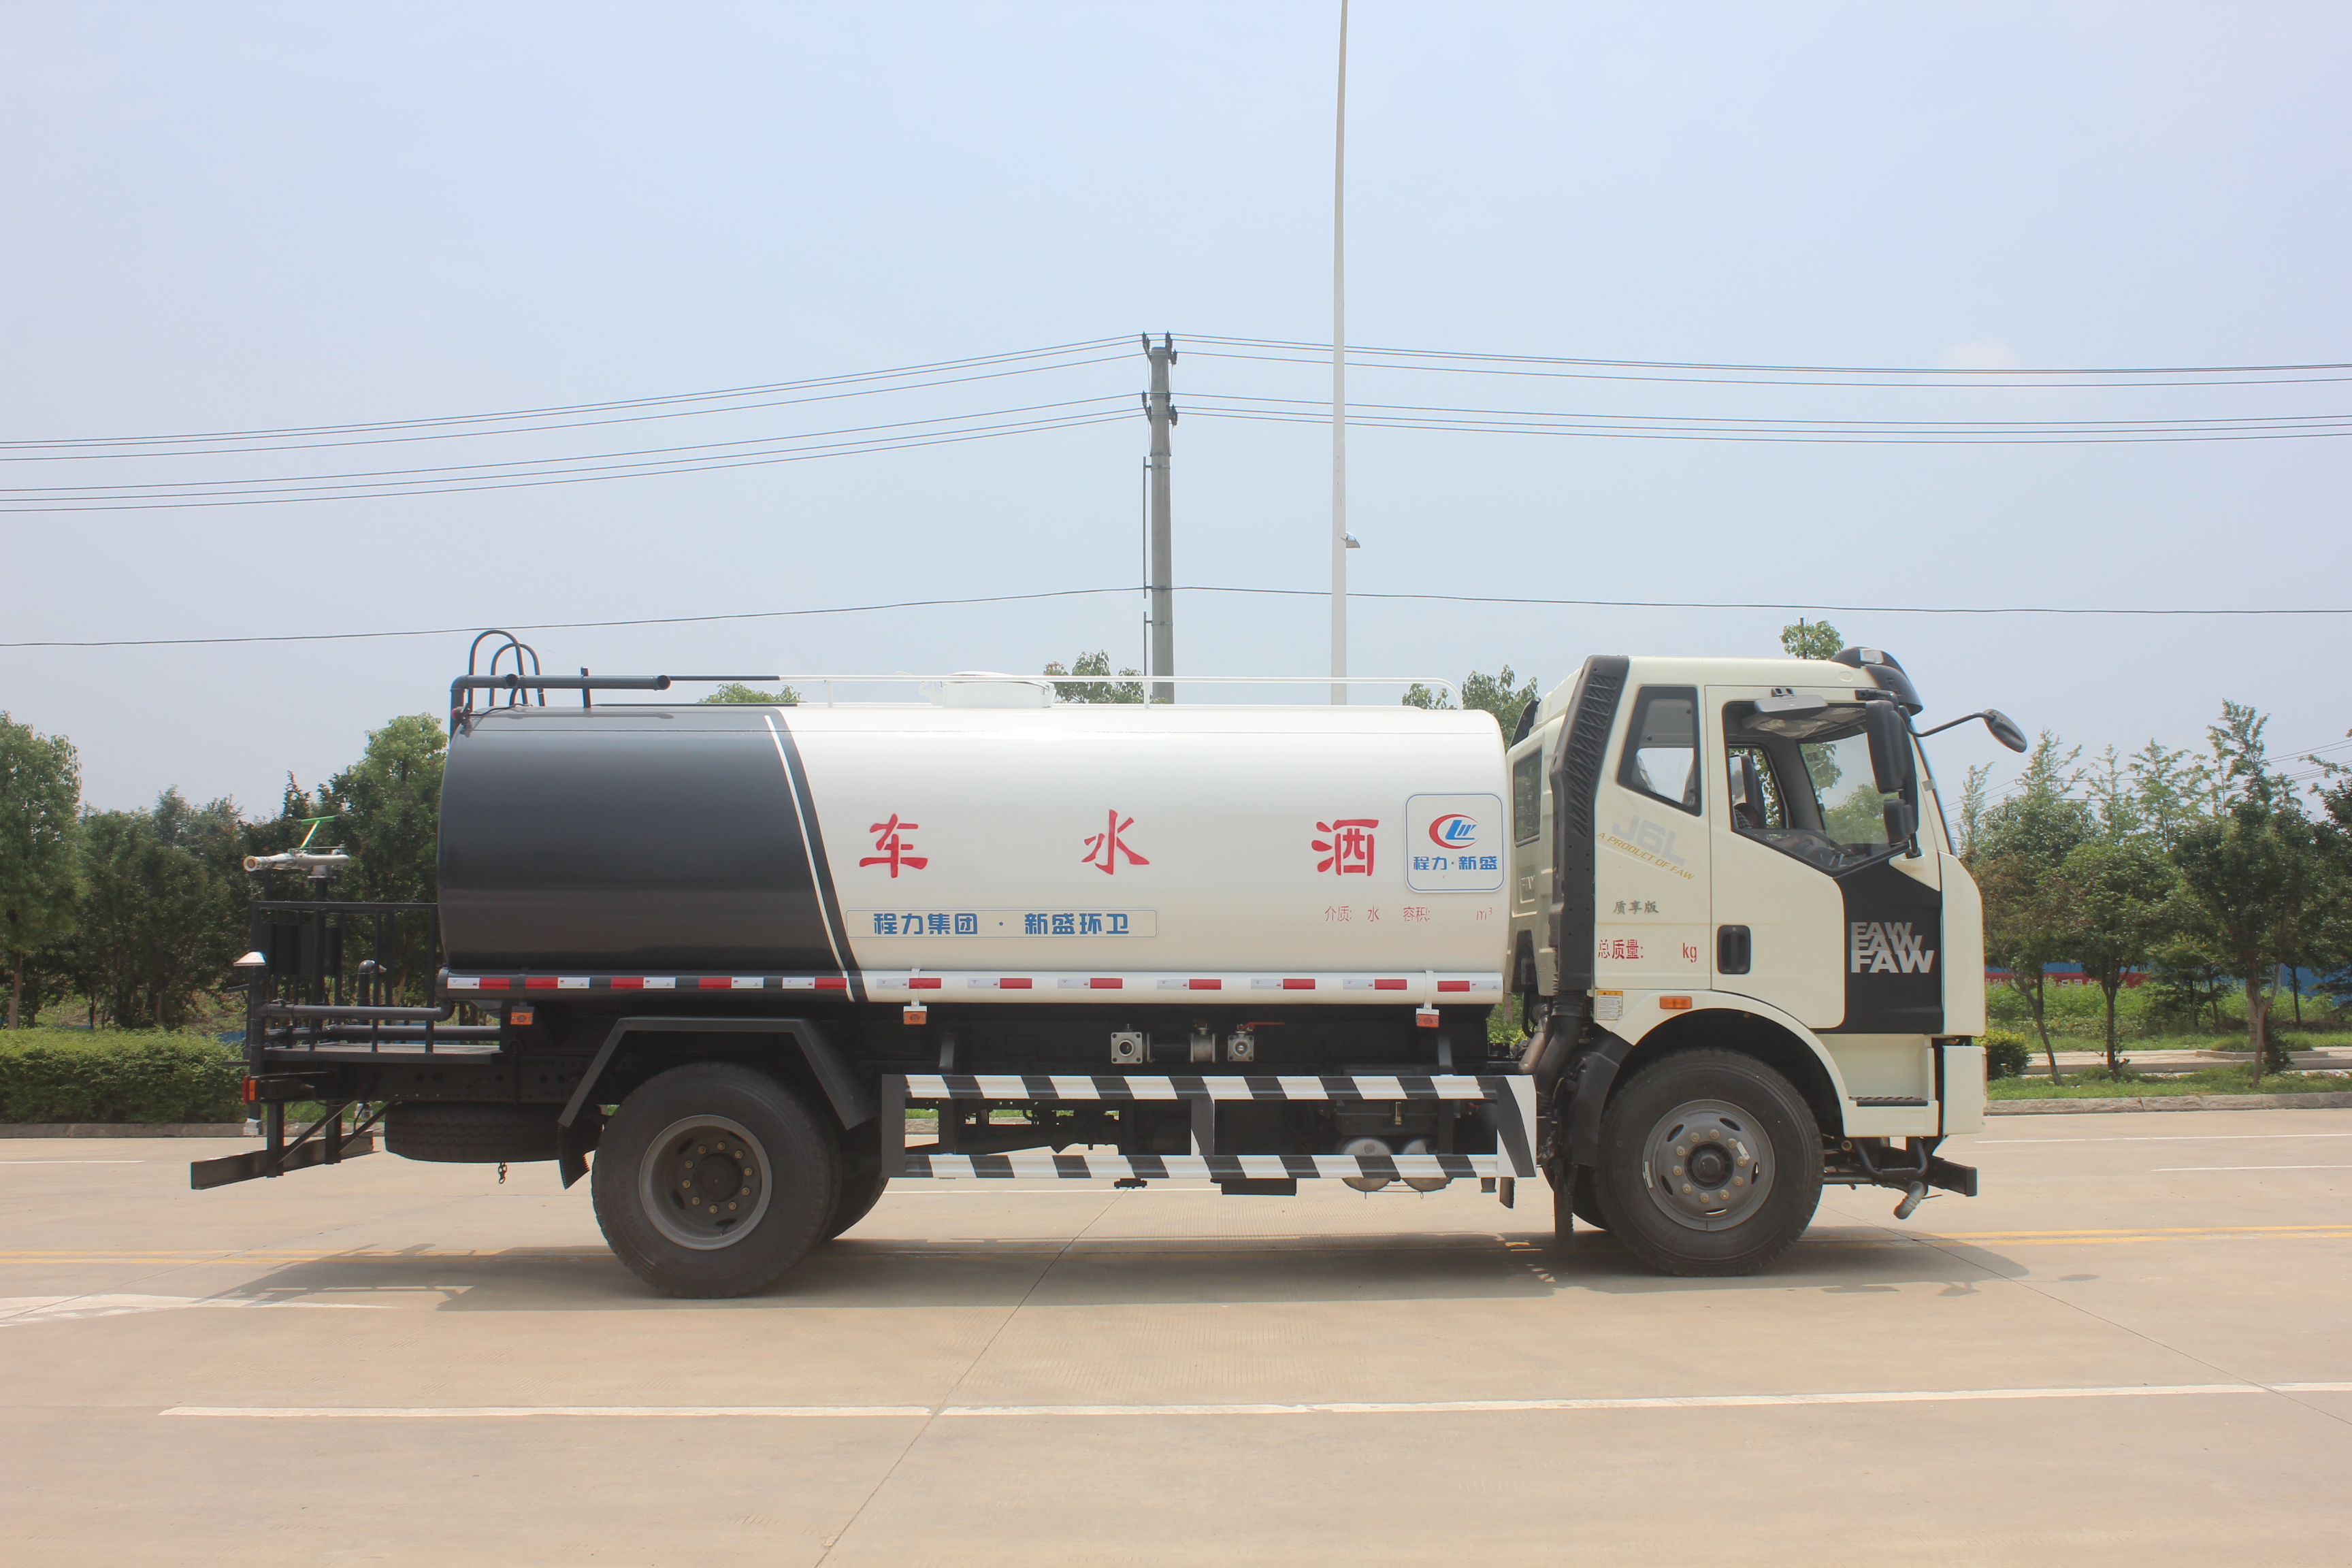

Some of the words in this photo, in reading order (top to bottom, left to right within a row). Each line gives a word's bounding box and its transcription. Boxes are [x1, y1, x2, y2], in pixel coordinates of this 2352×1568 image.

[860, 813, 928, 878] 车
[1081, 809, 1150, 875] 水
[1311, 819, 1379, 877] 洒
[1612, 815, 1685, 867] J6L
[1607, 836, 1655, 861] PRODUCT
[1654, 859, 1671, 868] OF
[1669, 866, 1695, 879] FAW
[1367, 906, 1379, 922] 水
[1612, 900, 1659, 915] 质享版
[873, 913, 978, 934] 程力集团
[1024, 913, 1130, 934] 新盛环卫
[1682, 942, 1697, 963] kg
[1851, 950, 1934, 973] FAW
